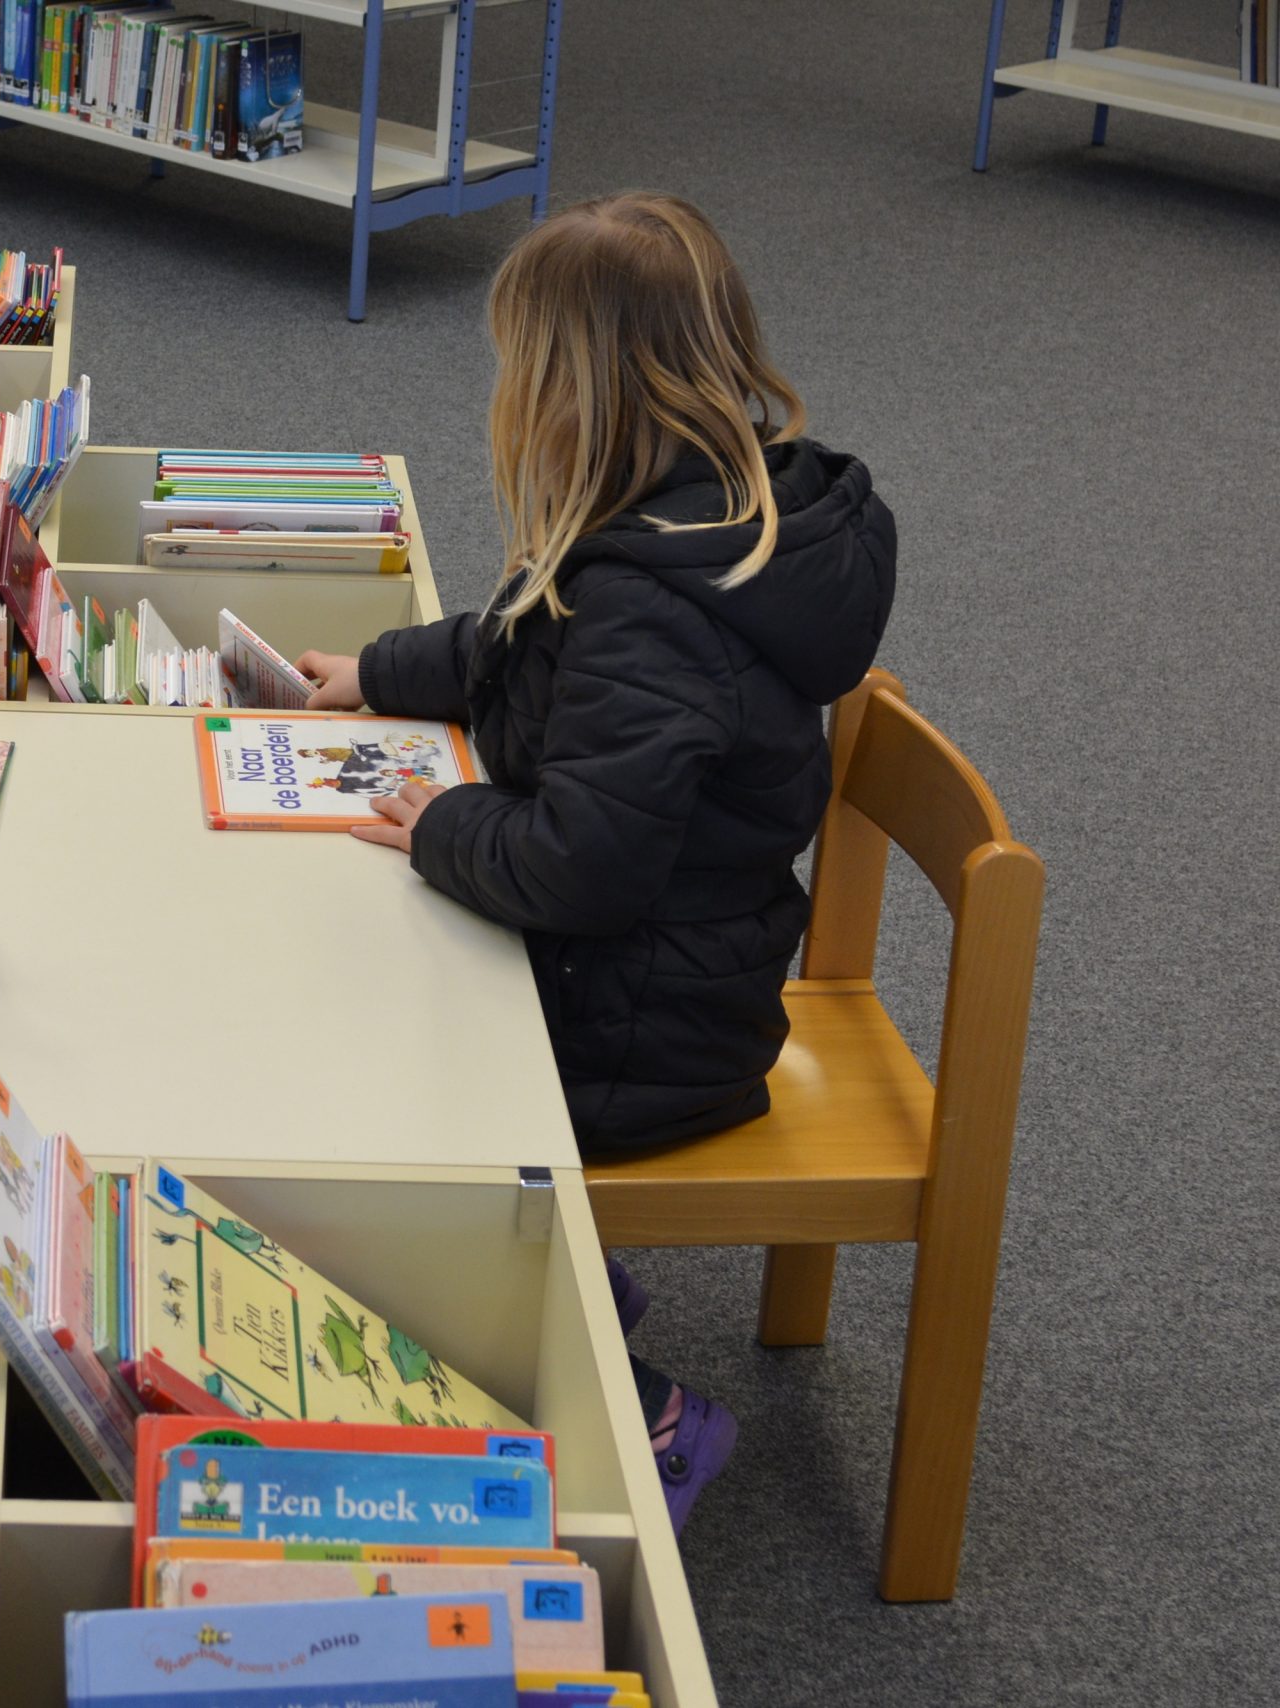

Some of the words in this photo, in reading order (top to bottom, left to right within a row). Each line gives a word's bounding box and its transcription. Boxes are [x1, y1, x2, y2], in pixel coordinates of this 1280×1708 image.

[239, 748, 265, 781] Naar
[260, 723, 298, 786] boerderij
[272, 788, 301, 809] de
[232, 1303, 262, 1344] Tien
[259, 1305, 289, 1382] Kikkers
[257, 1484, 320, 1515] Een
[336, 1487, 418, 1523] boek
[308, 1632, 362, 1657] ADHD
